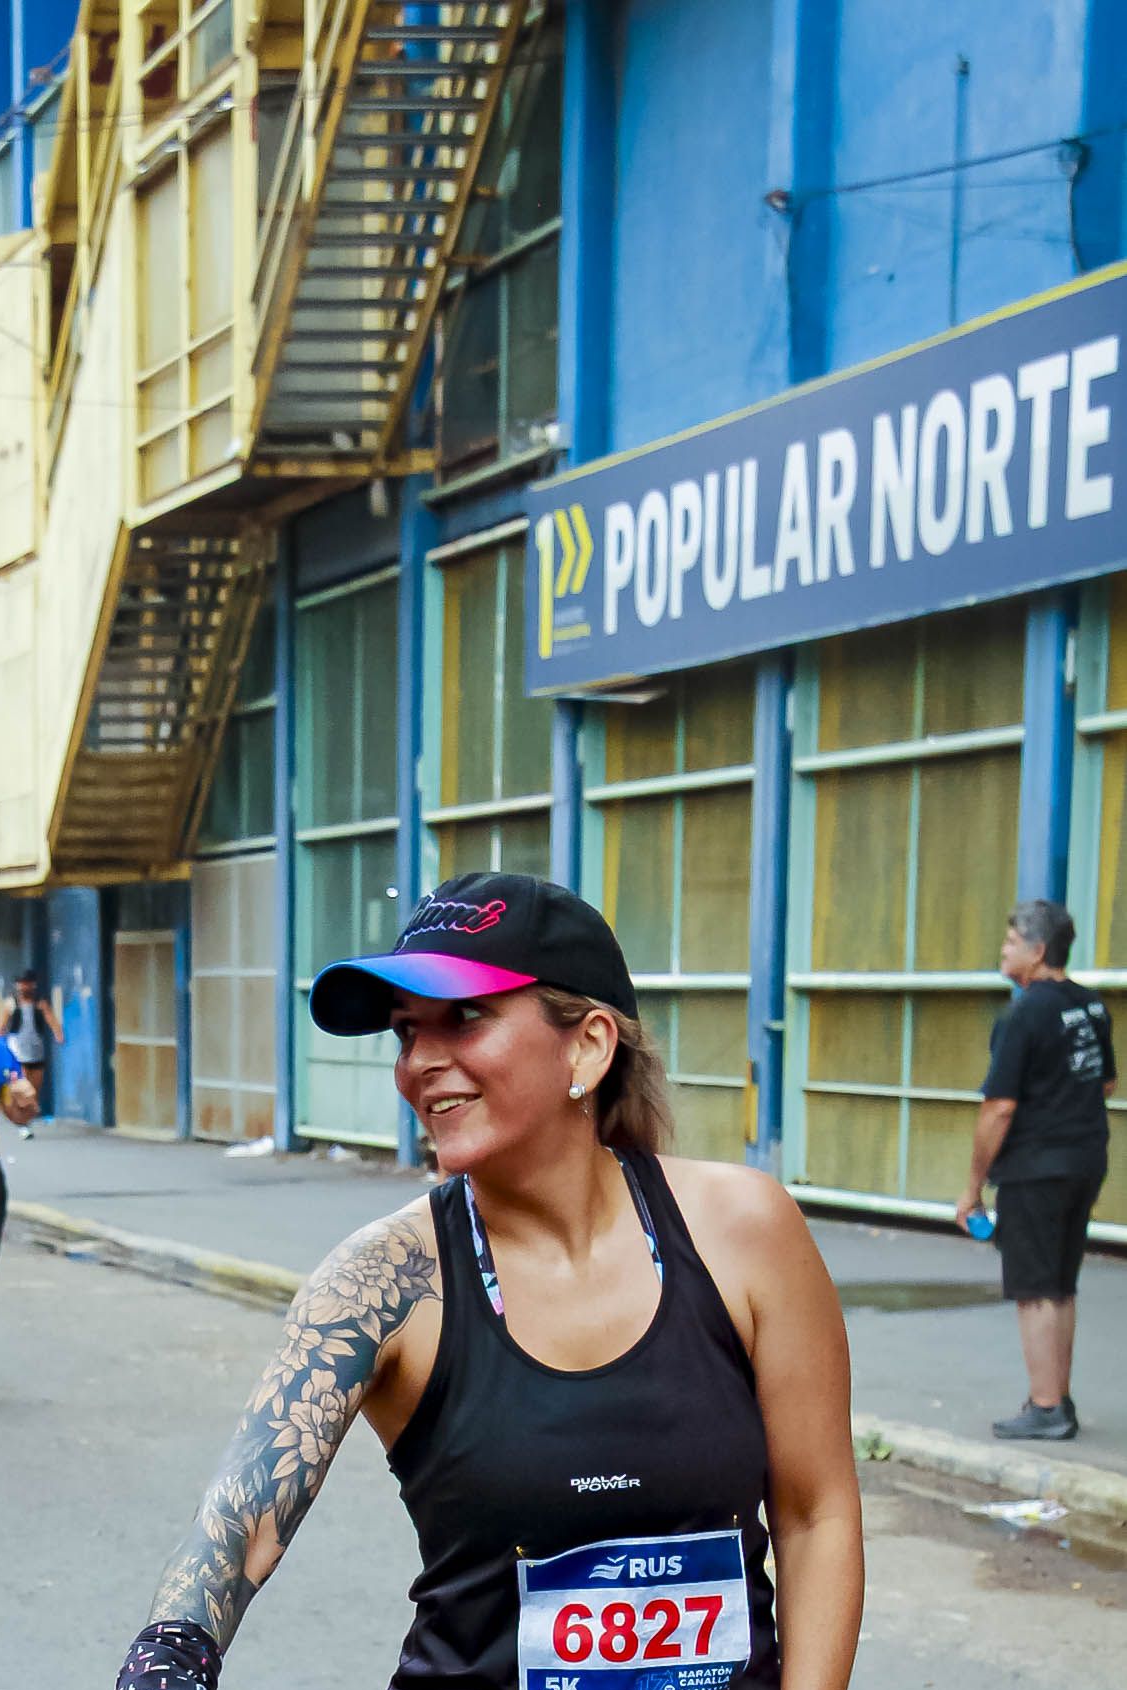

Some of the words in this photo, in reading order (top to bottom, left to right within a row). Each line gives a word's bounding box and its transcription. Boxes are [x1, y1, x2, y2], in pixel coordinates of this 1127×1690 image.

[603, 427, 858, 636] POPULAR
[869, 334, 1120, 569] NORTE
[570, 1476, 610, 1486] DUAL
[578, 1478, 641, 1493] POWER
[628, 1555, 683, 1579] RUS
[552, 1595, 724, 1663] 6827
[678, 1666, 733, 1679] MARATÓN
[679, 1675, 731, 1687] CANALLA
